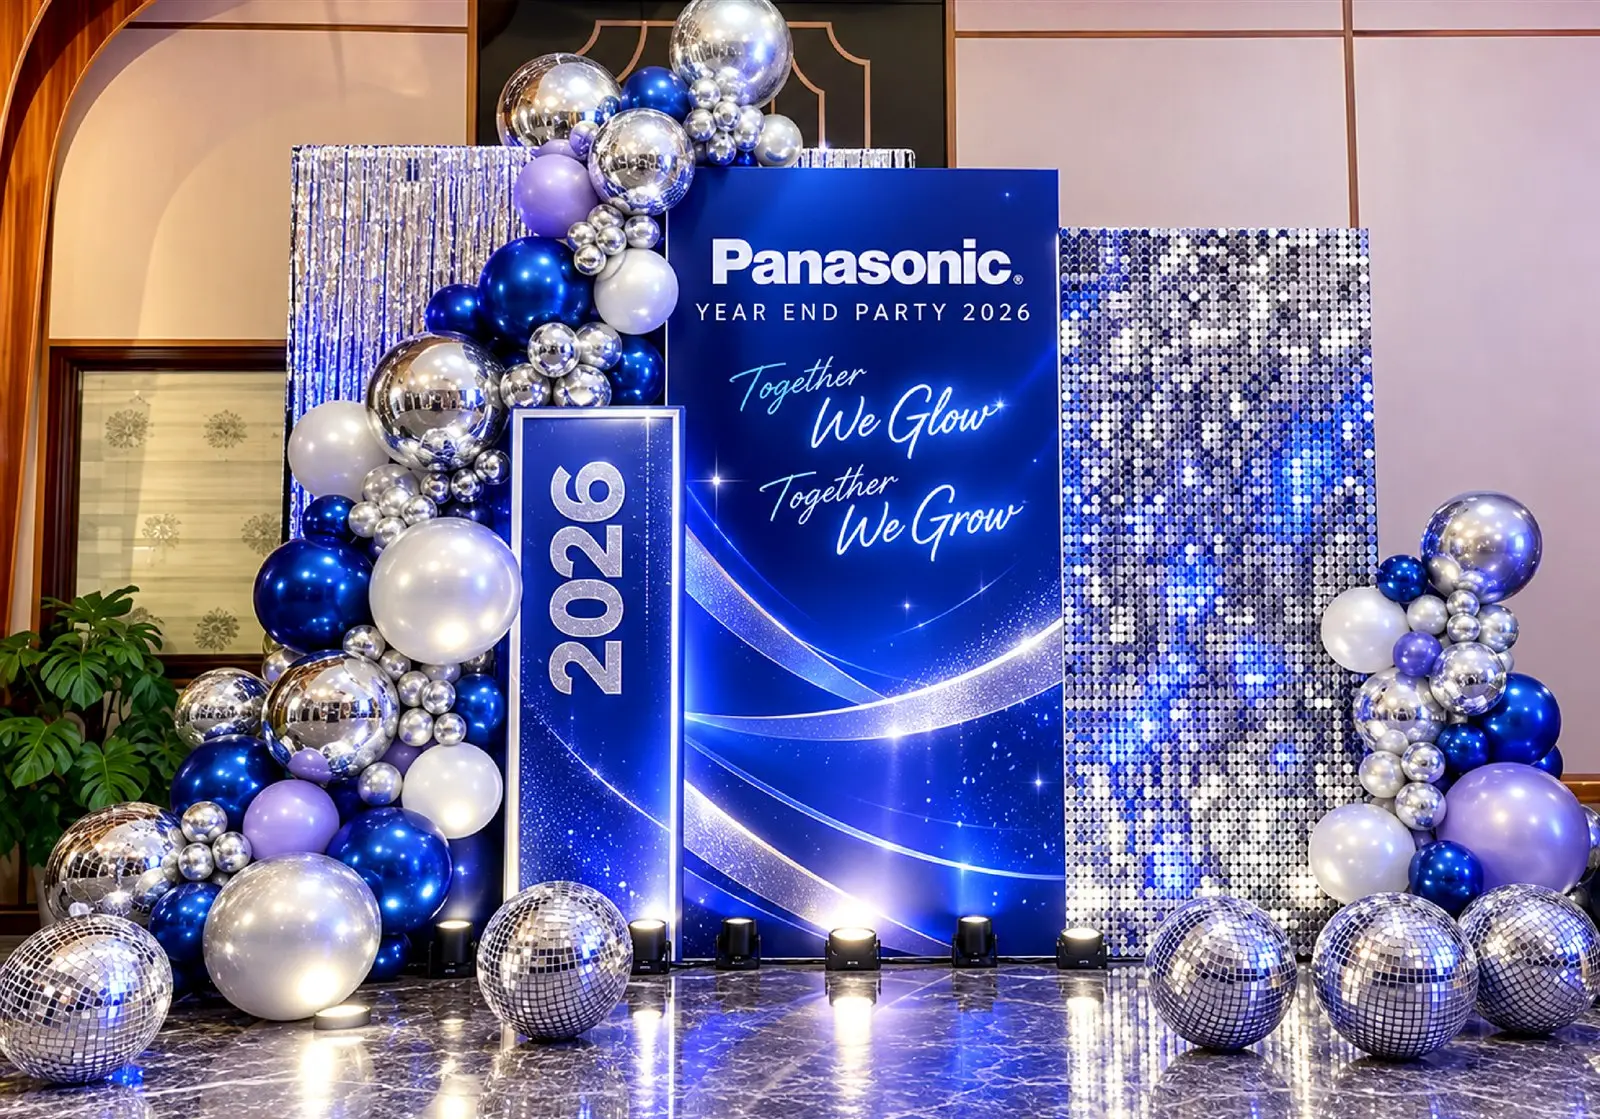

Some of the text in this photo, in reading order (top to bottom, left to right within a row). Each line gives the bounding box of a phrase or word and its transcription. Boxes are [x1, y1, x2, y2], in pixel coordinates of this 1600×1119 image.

[712, 238, 1012, 285] Panasonic
[695, 302, 1030, 322] YEAR END PARTY 2026
[729, 355, 868, 416] Together
[810, 383, 1000, 460] We Glow
[759, 463, 899, 525] Together
[836, 483, 1024, 563] We Grow
[548, 458, 626, 695] 2026
